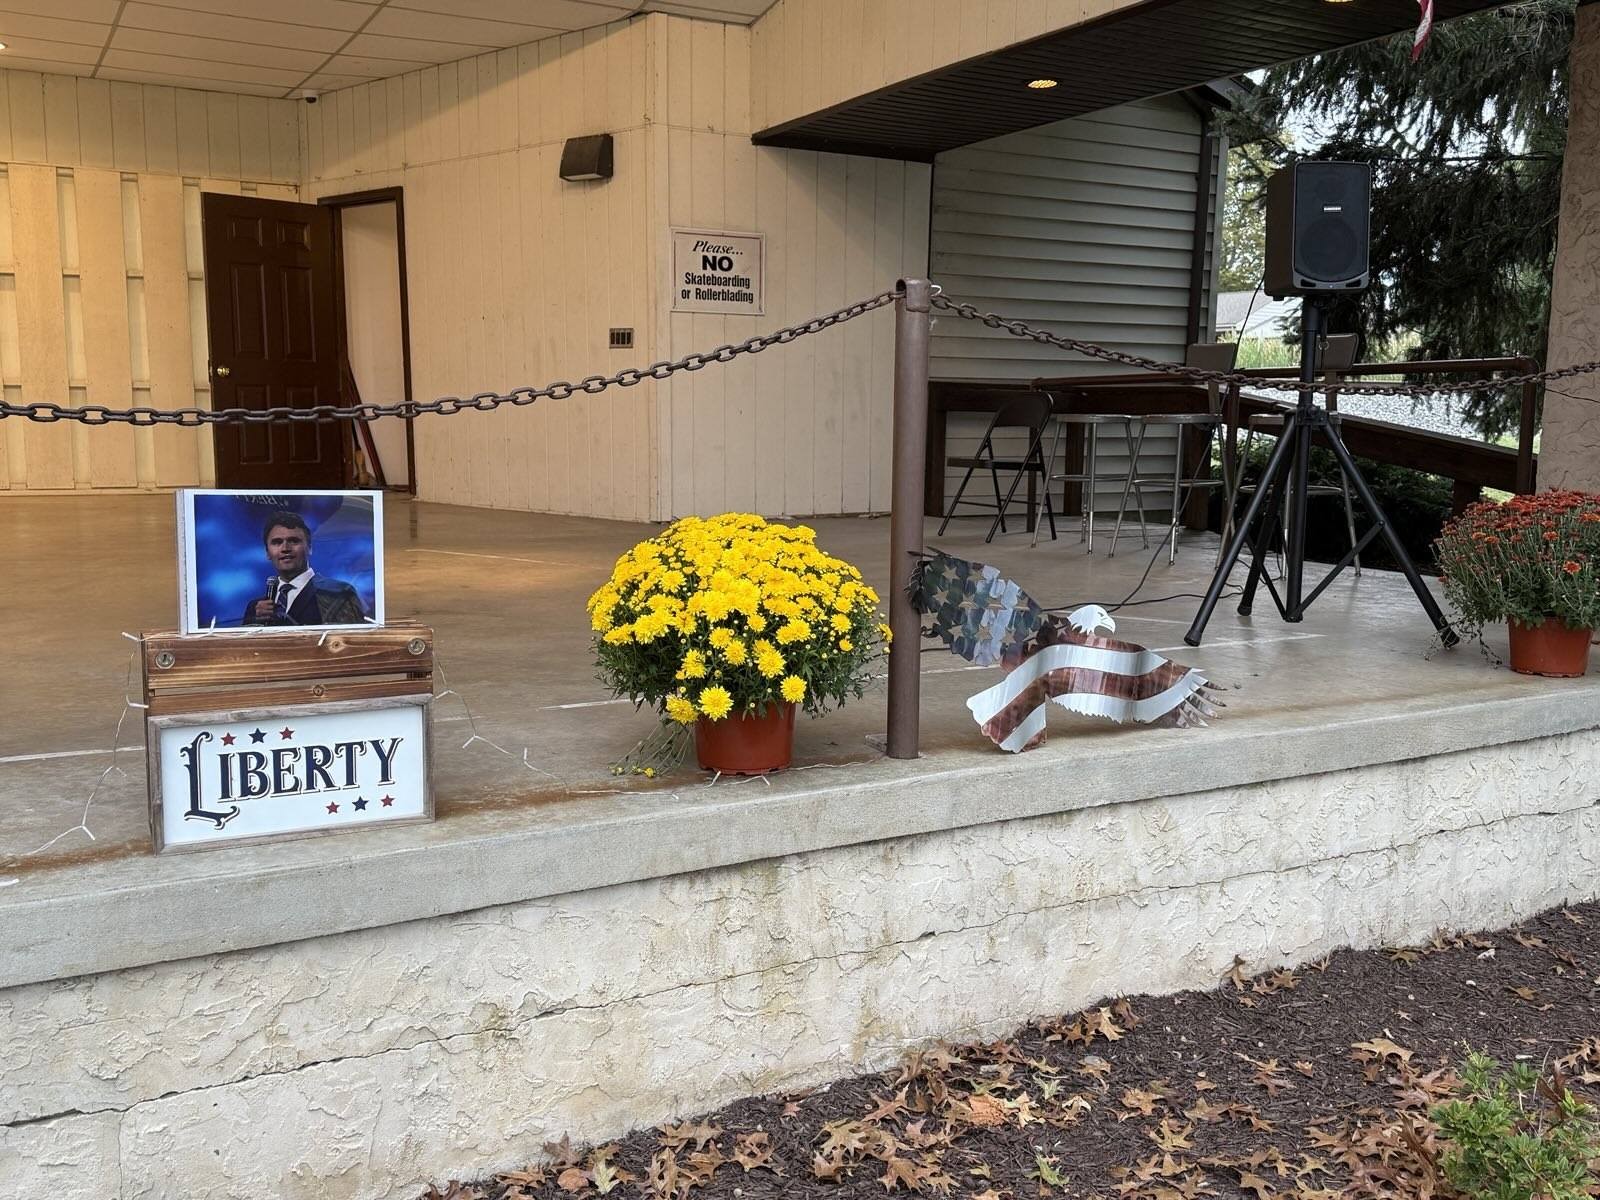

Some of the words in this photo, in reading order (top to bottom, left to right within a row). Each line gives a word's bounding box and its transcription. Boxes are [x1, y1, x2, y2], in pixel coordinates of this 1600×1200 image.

[693, 240, 743, 255] Please...
[702, 255, 733, 272] NO
[685, 272, 750, 289] Skateboarding
[681, 289, 691, 299] or
[695, 288, 754, 304] Rollerblading
[180, 731, 404, 830] LIBERTY
